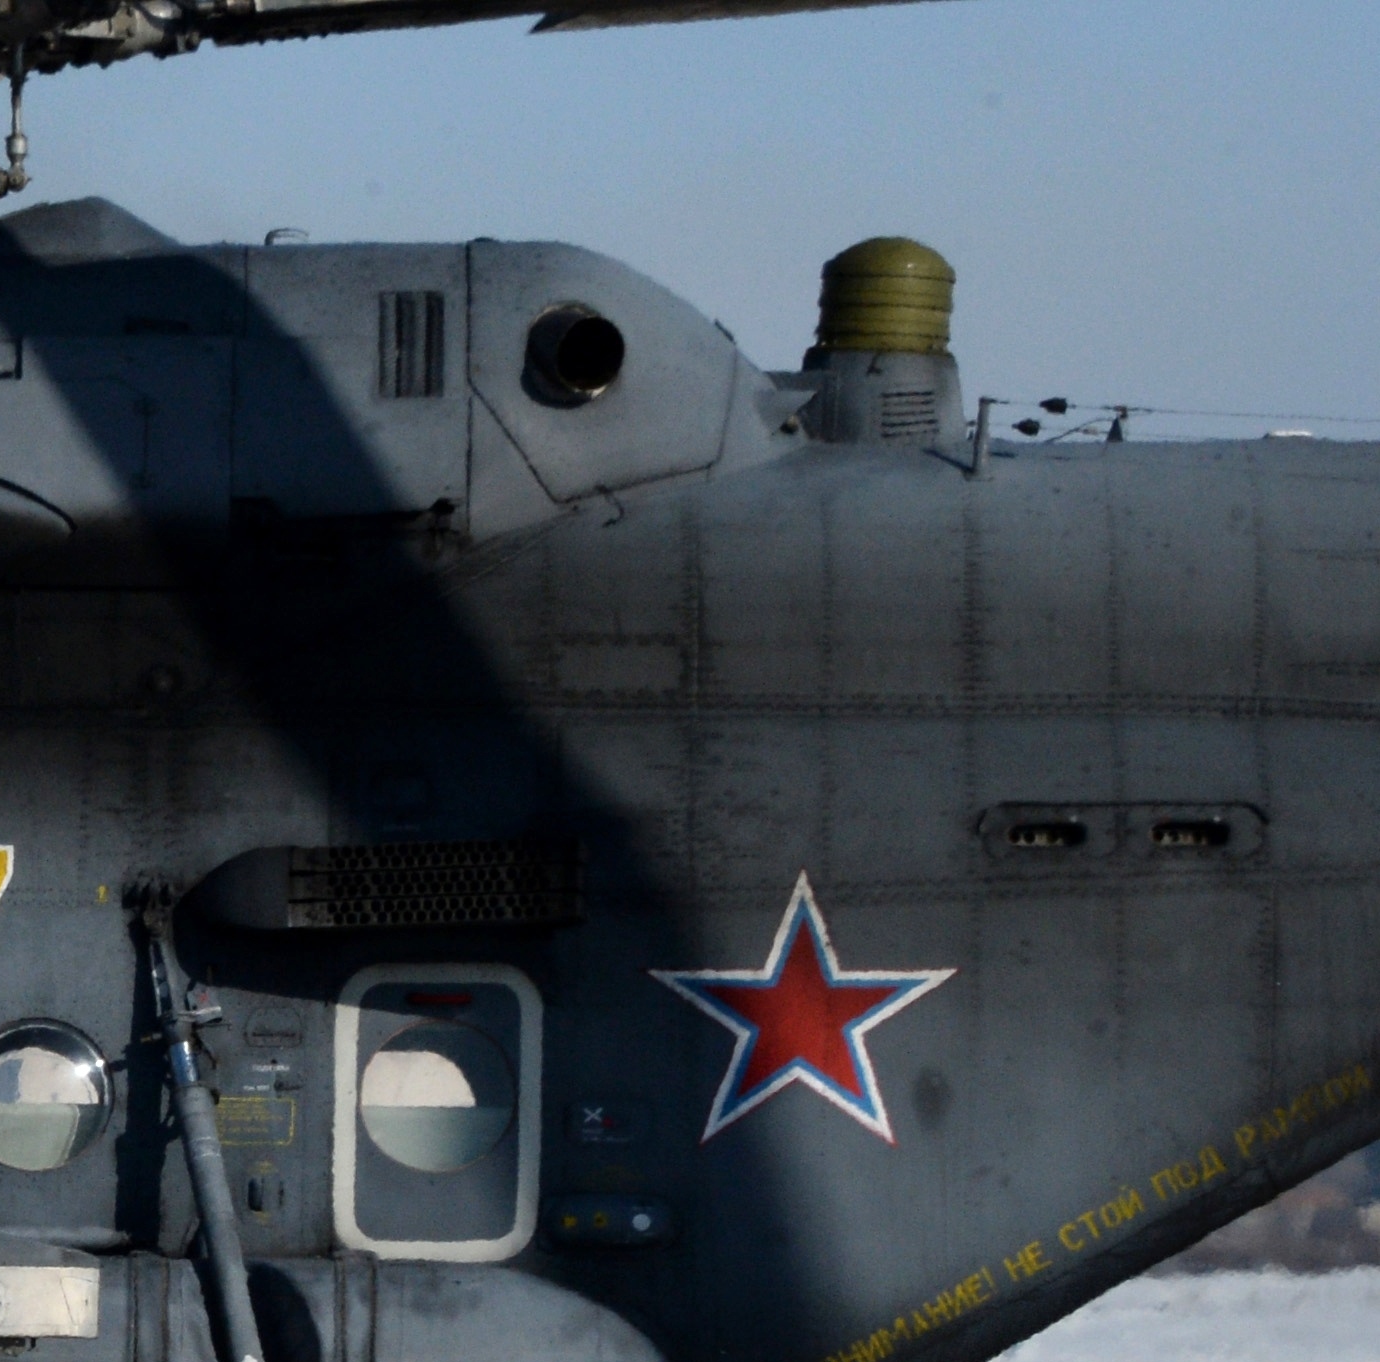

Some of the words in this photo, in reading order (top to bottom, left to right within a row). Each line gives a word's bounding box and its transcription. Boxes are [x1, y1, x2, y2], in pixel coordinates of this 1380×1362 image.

[1003, 1240, 1053, 1290] НЕ
[1058, 1184, 1145, 1253] СТОЙ
[1149, 1146, 1228, 1203] ПОД
